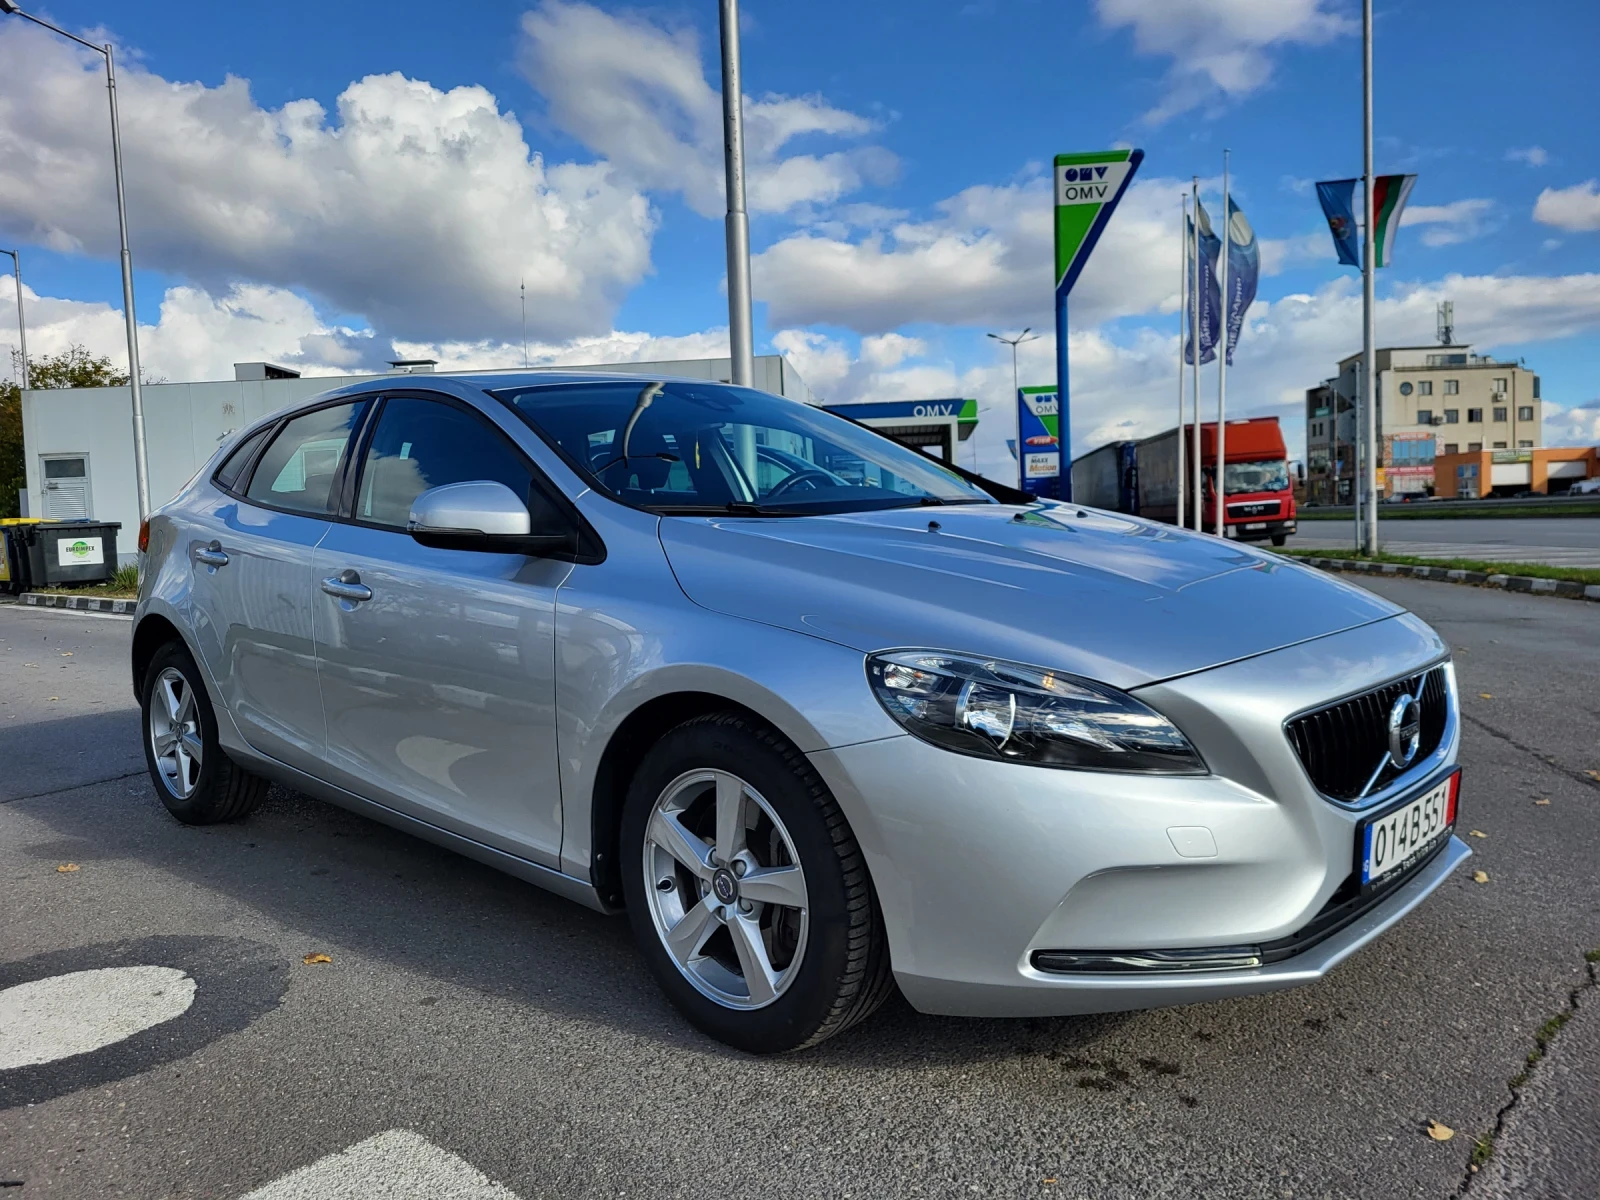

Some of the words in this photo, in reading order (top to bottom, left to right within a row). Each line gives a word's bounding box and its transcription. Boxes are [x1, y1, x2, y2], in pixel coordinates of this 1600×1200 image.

[1065, 185, 1108, 200] OMV
[913, 404, 953, 418] OMV
[1375, 785, 1447, 868] 014B551
